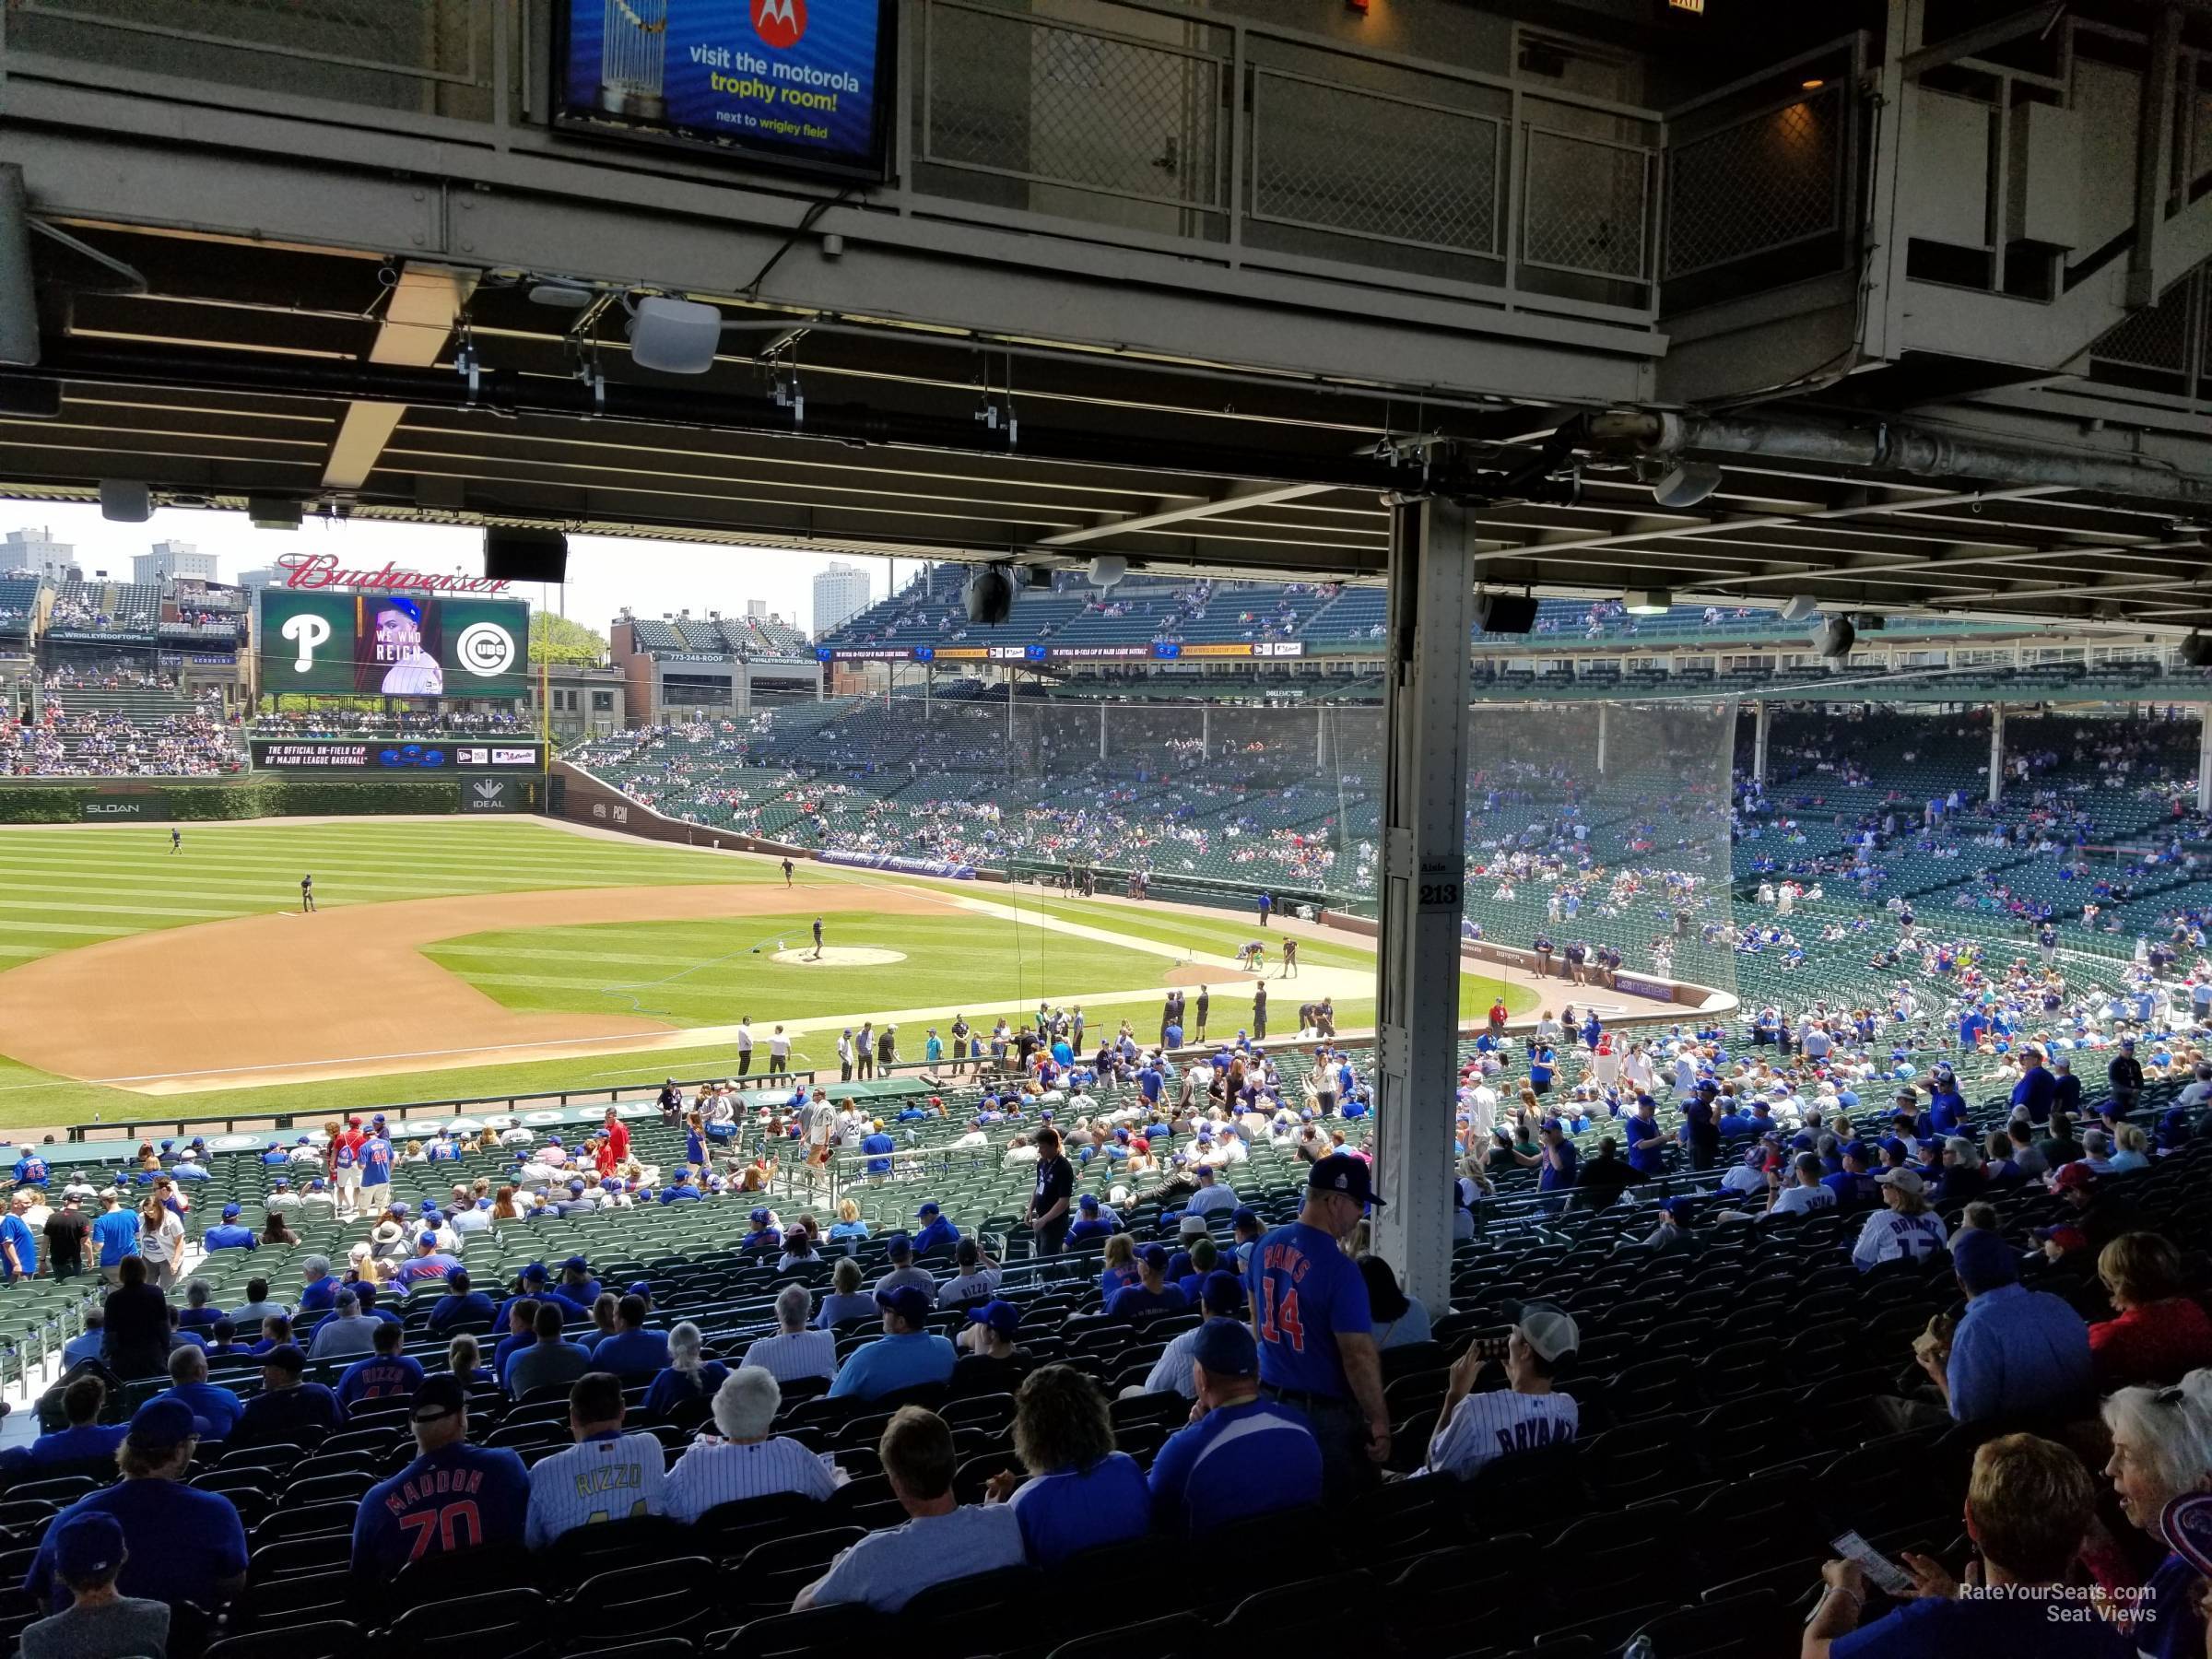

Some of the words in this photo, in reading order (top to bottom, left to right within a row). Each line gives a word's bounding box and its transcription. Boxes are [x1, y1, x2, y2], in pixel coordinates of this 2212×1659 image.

[689, 44, 730, 69] visit
[735, 51, 768, 76] the
[771, 60, 860, 93] motorola
[710, 72, 778, 104] trophy
[781, 86, 838, 112] room!
[715, 109, 743, 125] next
[743, 112, 758, 127] to
[759, 116, 802, 137] wrigley
[802, 122, 828, 139] field
[278, 552, 511, 593] Budweiser
[376, 629, 393, 642] WE
[397, 630, 421, 643] WHO
[376, 643, 421, 661] REIGN
[670, 653, 724, 663] 773-248-ROOF
[265, 755, 275, 765] OF
[276, 755, 300, 765] MAJOR
[302, 755, 329, 765] LEAGUE
[268, 746, 281, 755] THE
[284, 746, 315, 755] OFFICIAL
[317, 746, 350, 755] ON-FIELD
[351, 746, 367, 755] CAP
[86, 804, 140, 813] SLOAN
[473, 800, 506, 808] IDEAL
[888, 857, 925, 870] Reynolds
[924, 862, 947, 875] Wrap
[1420, 883, 1458, 905] 213
[1632, 982, 1671, 999] matters
[1889, 1216, 1939, 1236] BRYANT
[961, 1282, 988, 1299] RIZZO
[1261, 1276, 1305, 1352] 14
[574, 1463, 642, 1499] RIZZO
[384, 1468, 485, 1516] MADDON
[398, 1499, 484, 1563] 70
